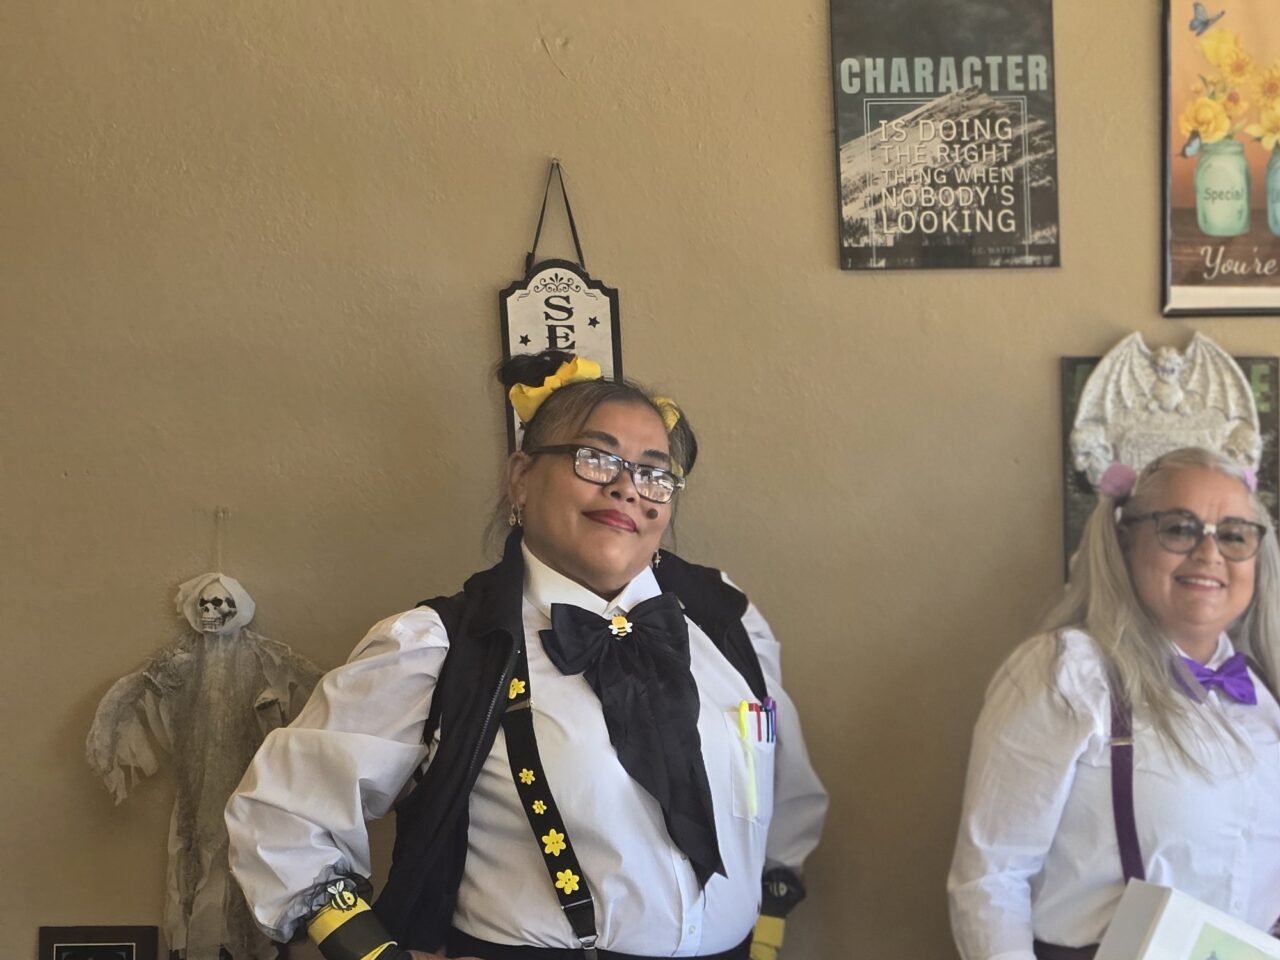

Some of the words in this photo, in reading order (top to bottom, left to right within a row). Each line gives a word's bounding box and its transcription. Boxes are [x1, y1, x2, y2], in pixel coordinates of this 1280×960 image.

[840, 54, 1048, 94] CHARACTER
[879, 120, 906, 142] IS
[919, 118, 1012, 140] DOING
[881, 145, 927, 165] THE
[937, 143, 1011, 163] RIGHT
[882, 168, 947, 185] THING
[953, 167, 1014, 183] WHEN
[882, 185, 1015, 207] NOBODY'S
[1203, 187, 1244, 204] Special
[882, 210, 1016, 234] LOOKING
[1200, 245, 1278, 280] You're
